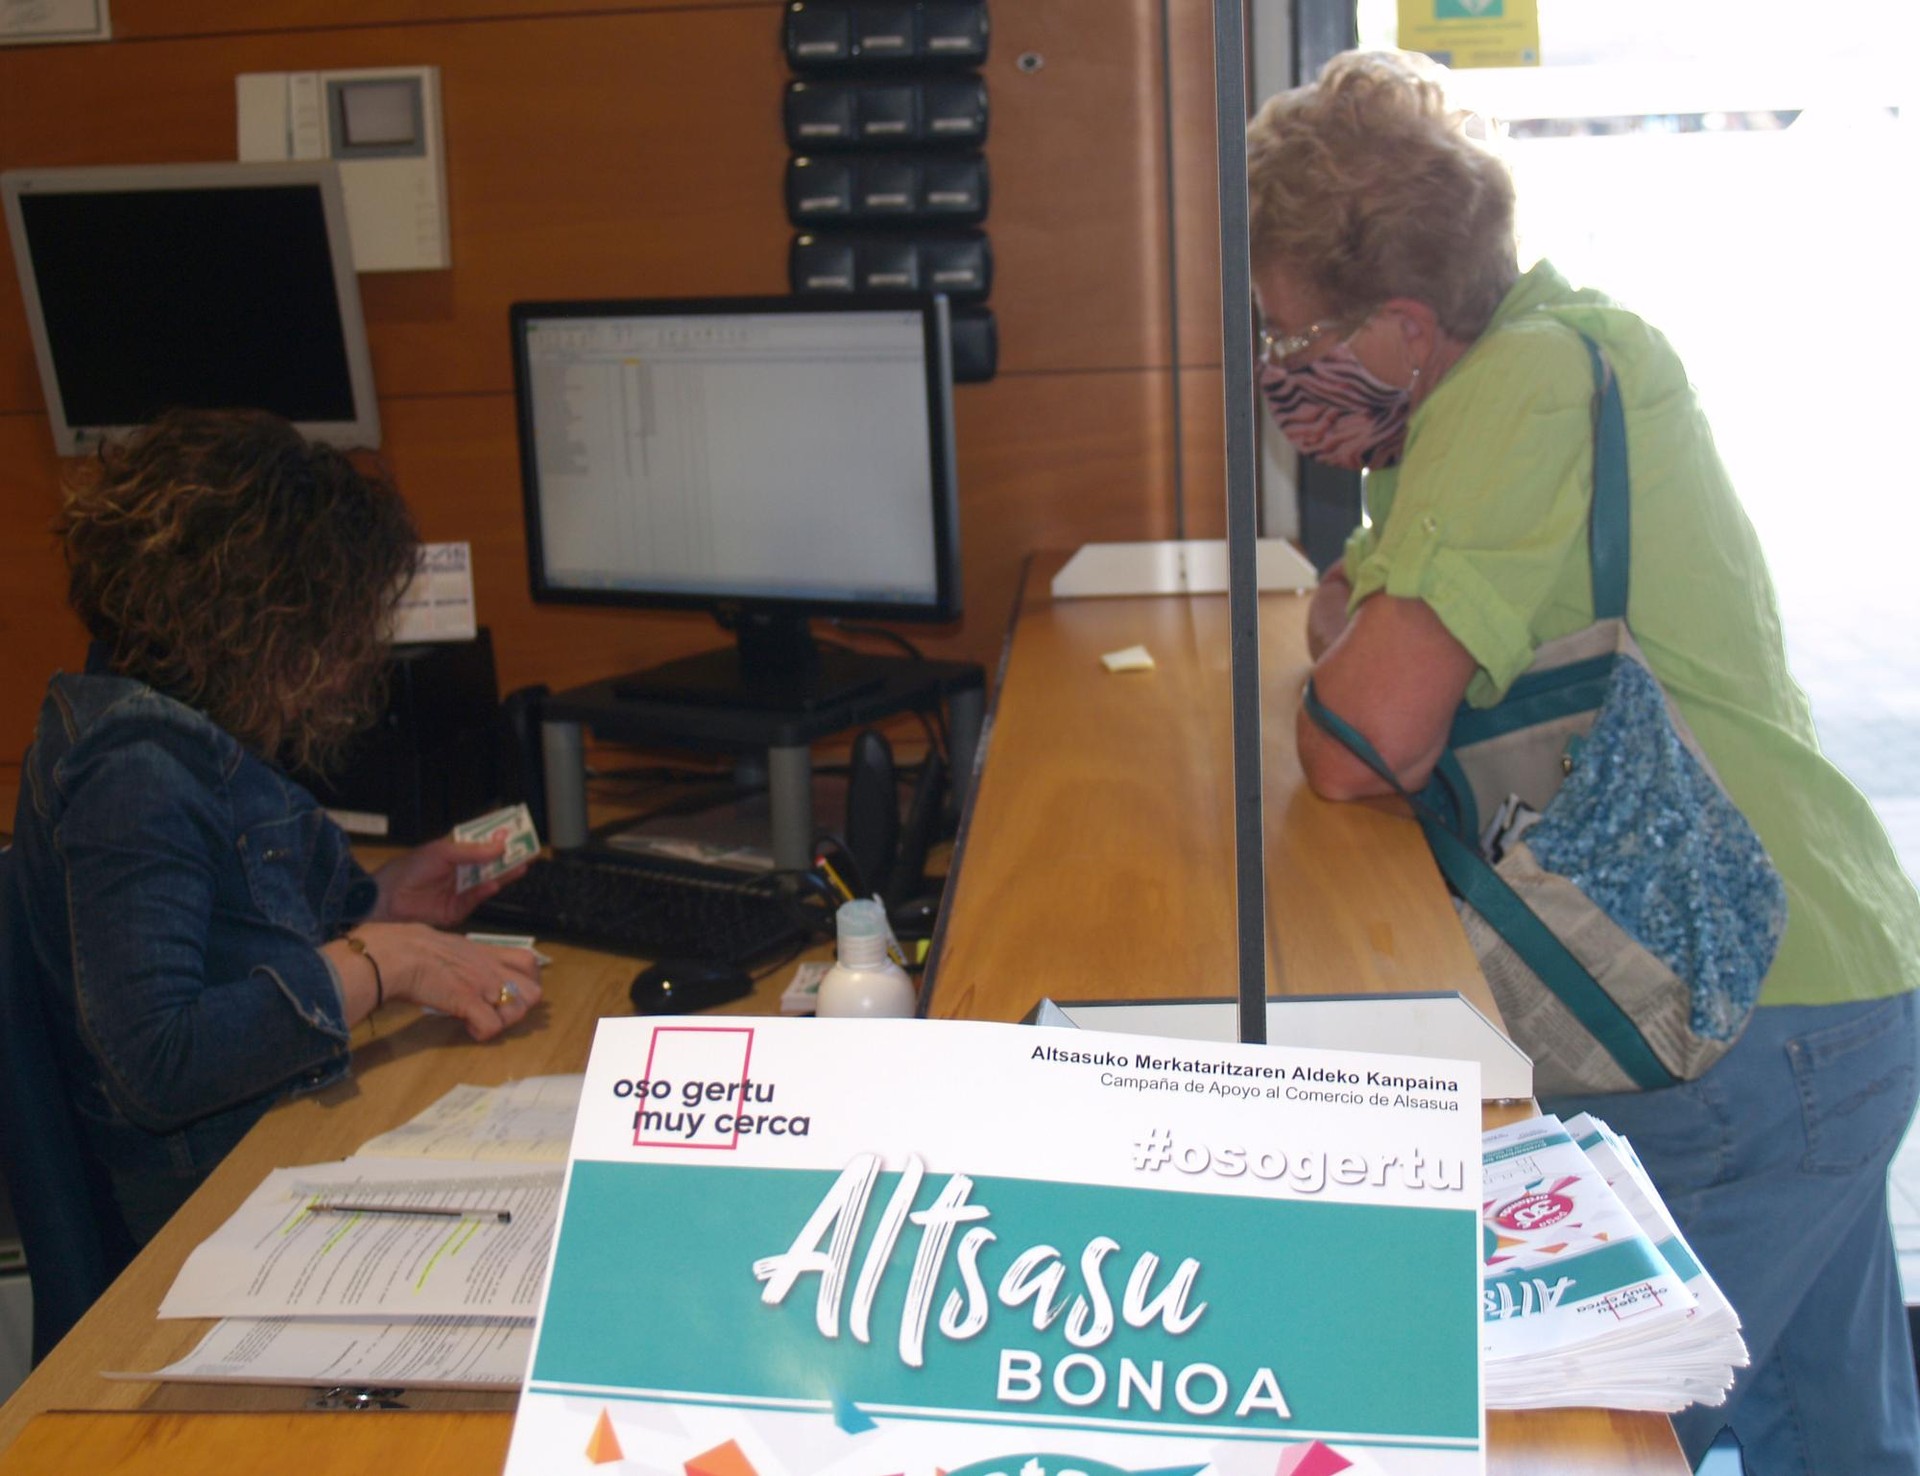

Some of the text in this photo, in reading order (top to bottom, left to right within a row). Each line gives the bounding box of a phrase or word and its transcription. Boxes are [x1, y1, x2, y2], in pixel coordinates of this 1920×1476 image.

[1031, 1045, 1459, 1092] Altsasuko Merkataritzaren Aldeko Kanpaina
[1100, 1072, 1459, 1112] Campaña de Apoyo al Comercio de Alsasua
[613, 1079, 775, 1108] oso gertu
[632, 1110, 811, 1139] muy cerca
[1133, 1128, 1464, 1193] #osogertu
[752, 1152, 1208, 1367] Altsasu
[996, 1348, 1292, 1419] BONOA
